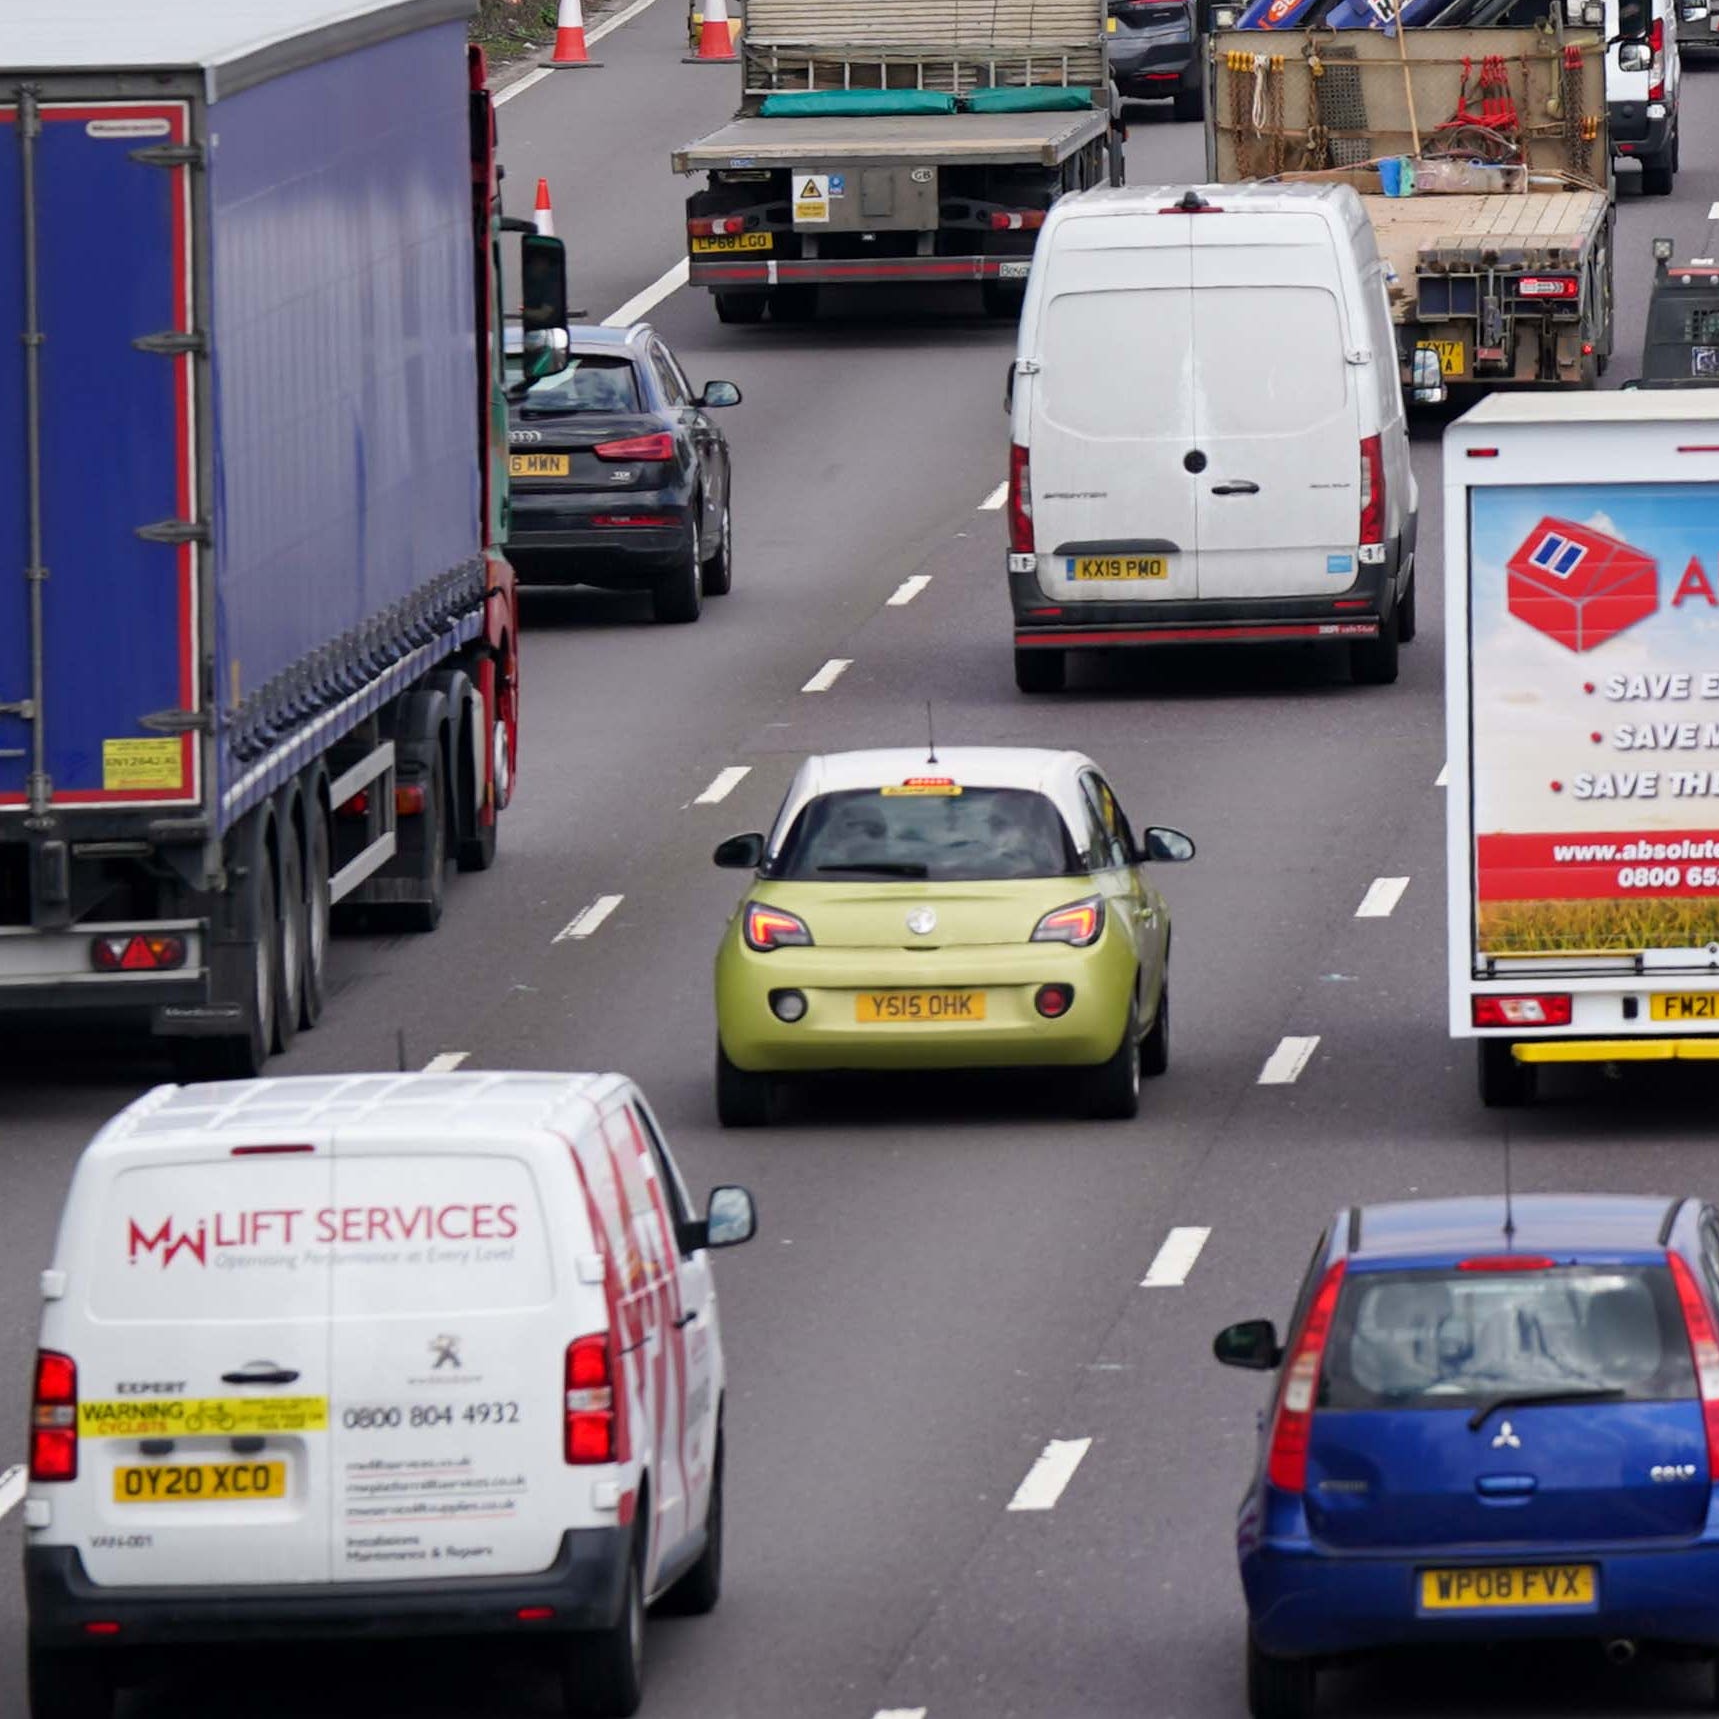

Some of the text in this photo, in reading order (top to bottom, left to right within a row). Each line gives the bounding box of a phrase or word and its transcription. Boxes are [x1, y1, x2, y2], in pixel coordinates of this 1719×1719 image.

[698, 234, 768, 250] LP68 LGO
[527, 455, 561, 473] MWN
[1081, 559, 1162, 577] KX19 PMO
[1605, 673, 1691, 701] SAVE
[1613, 721, 1698, 750] SAVE
[1572, 770, 1658, 800] SAVE
[1617, 867, 1681, 889] 0800
[872, 994, 922, 1017] YS15
[1664, 995, 1716, 1016] FM21
[213, 1210, 304, 1247] LIFT
[314, 1204, 518, 1244] SERVICES
[427, 1247, 470, 1266] Every
[474, 1245, 516, 1262] Level
[116, 1381, 187, 1394] EXPERT
[82, 1401, 185, 1420] WARNING
[343, 1406, 402, 1429] 0800
[408, 1404, 453, 1428] 804
[461, 1402, 521, 1424] 4932
[125, 1464, 271, 1496] OY20 XCO
[1435, 1570, 1580, 1601] WP08 FVX
